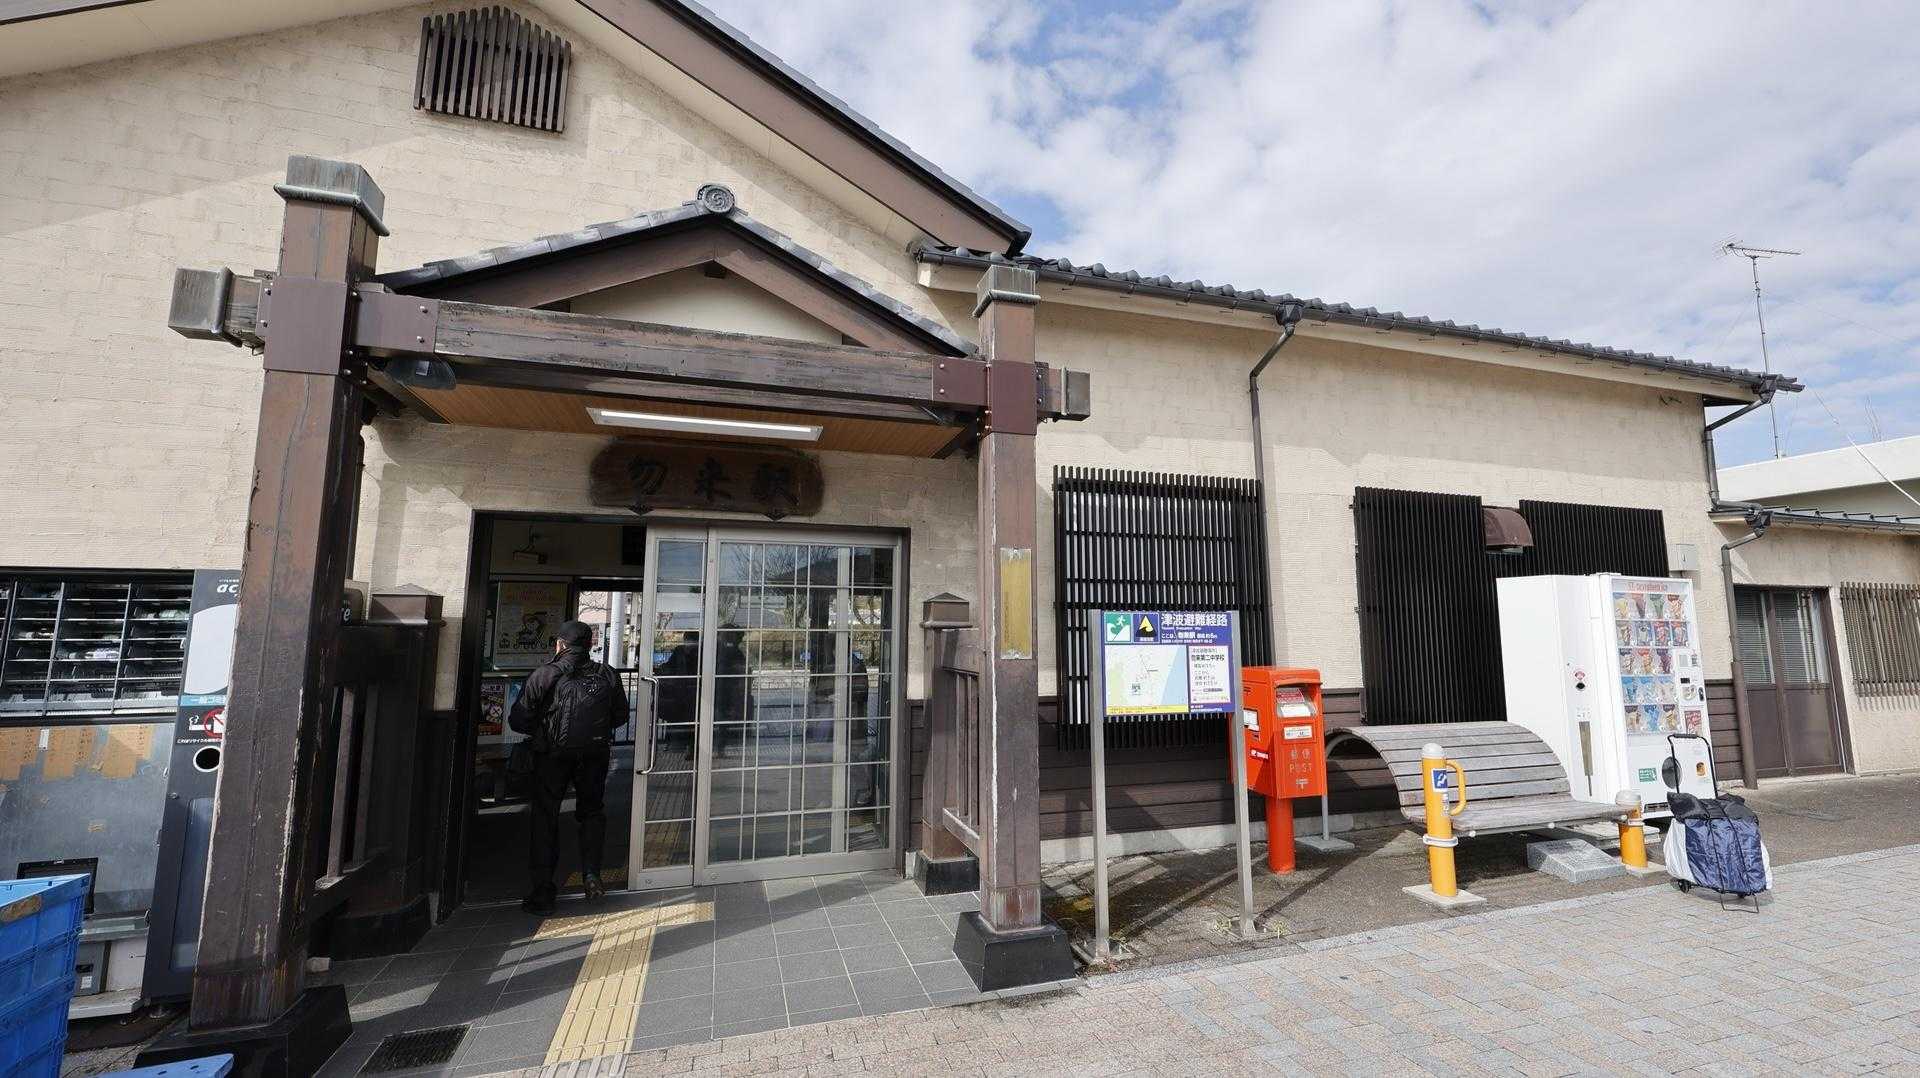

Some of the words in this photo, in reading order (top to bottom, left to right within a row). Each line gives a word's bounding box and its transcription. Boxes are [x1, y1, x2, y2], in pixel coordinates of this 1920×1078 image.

[1161, 613, 1228, 627] 津波避難経路
